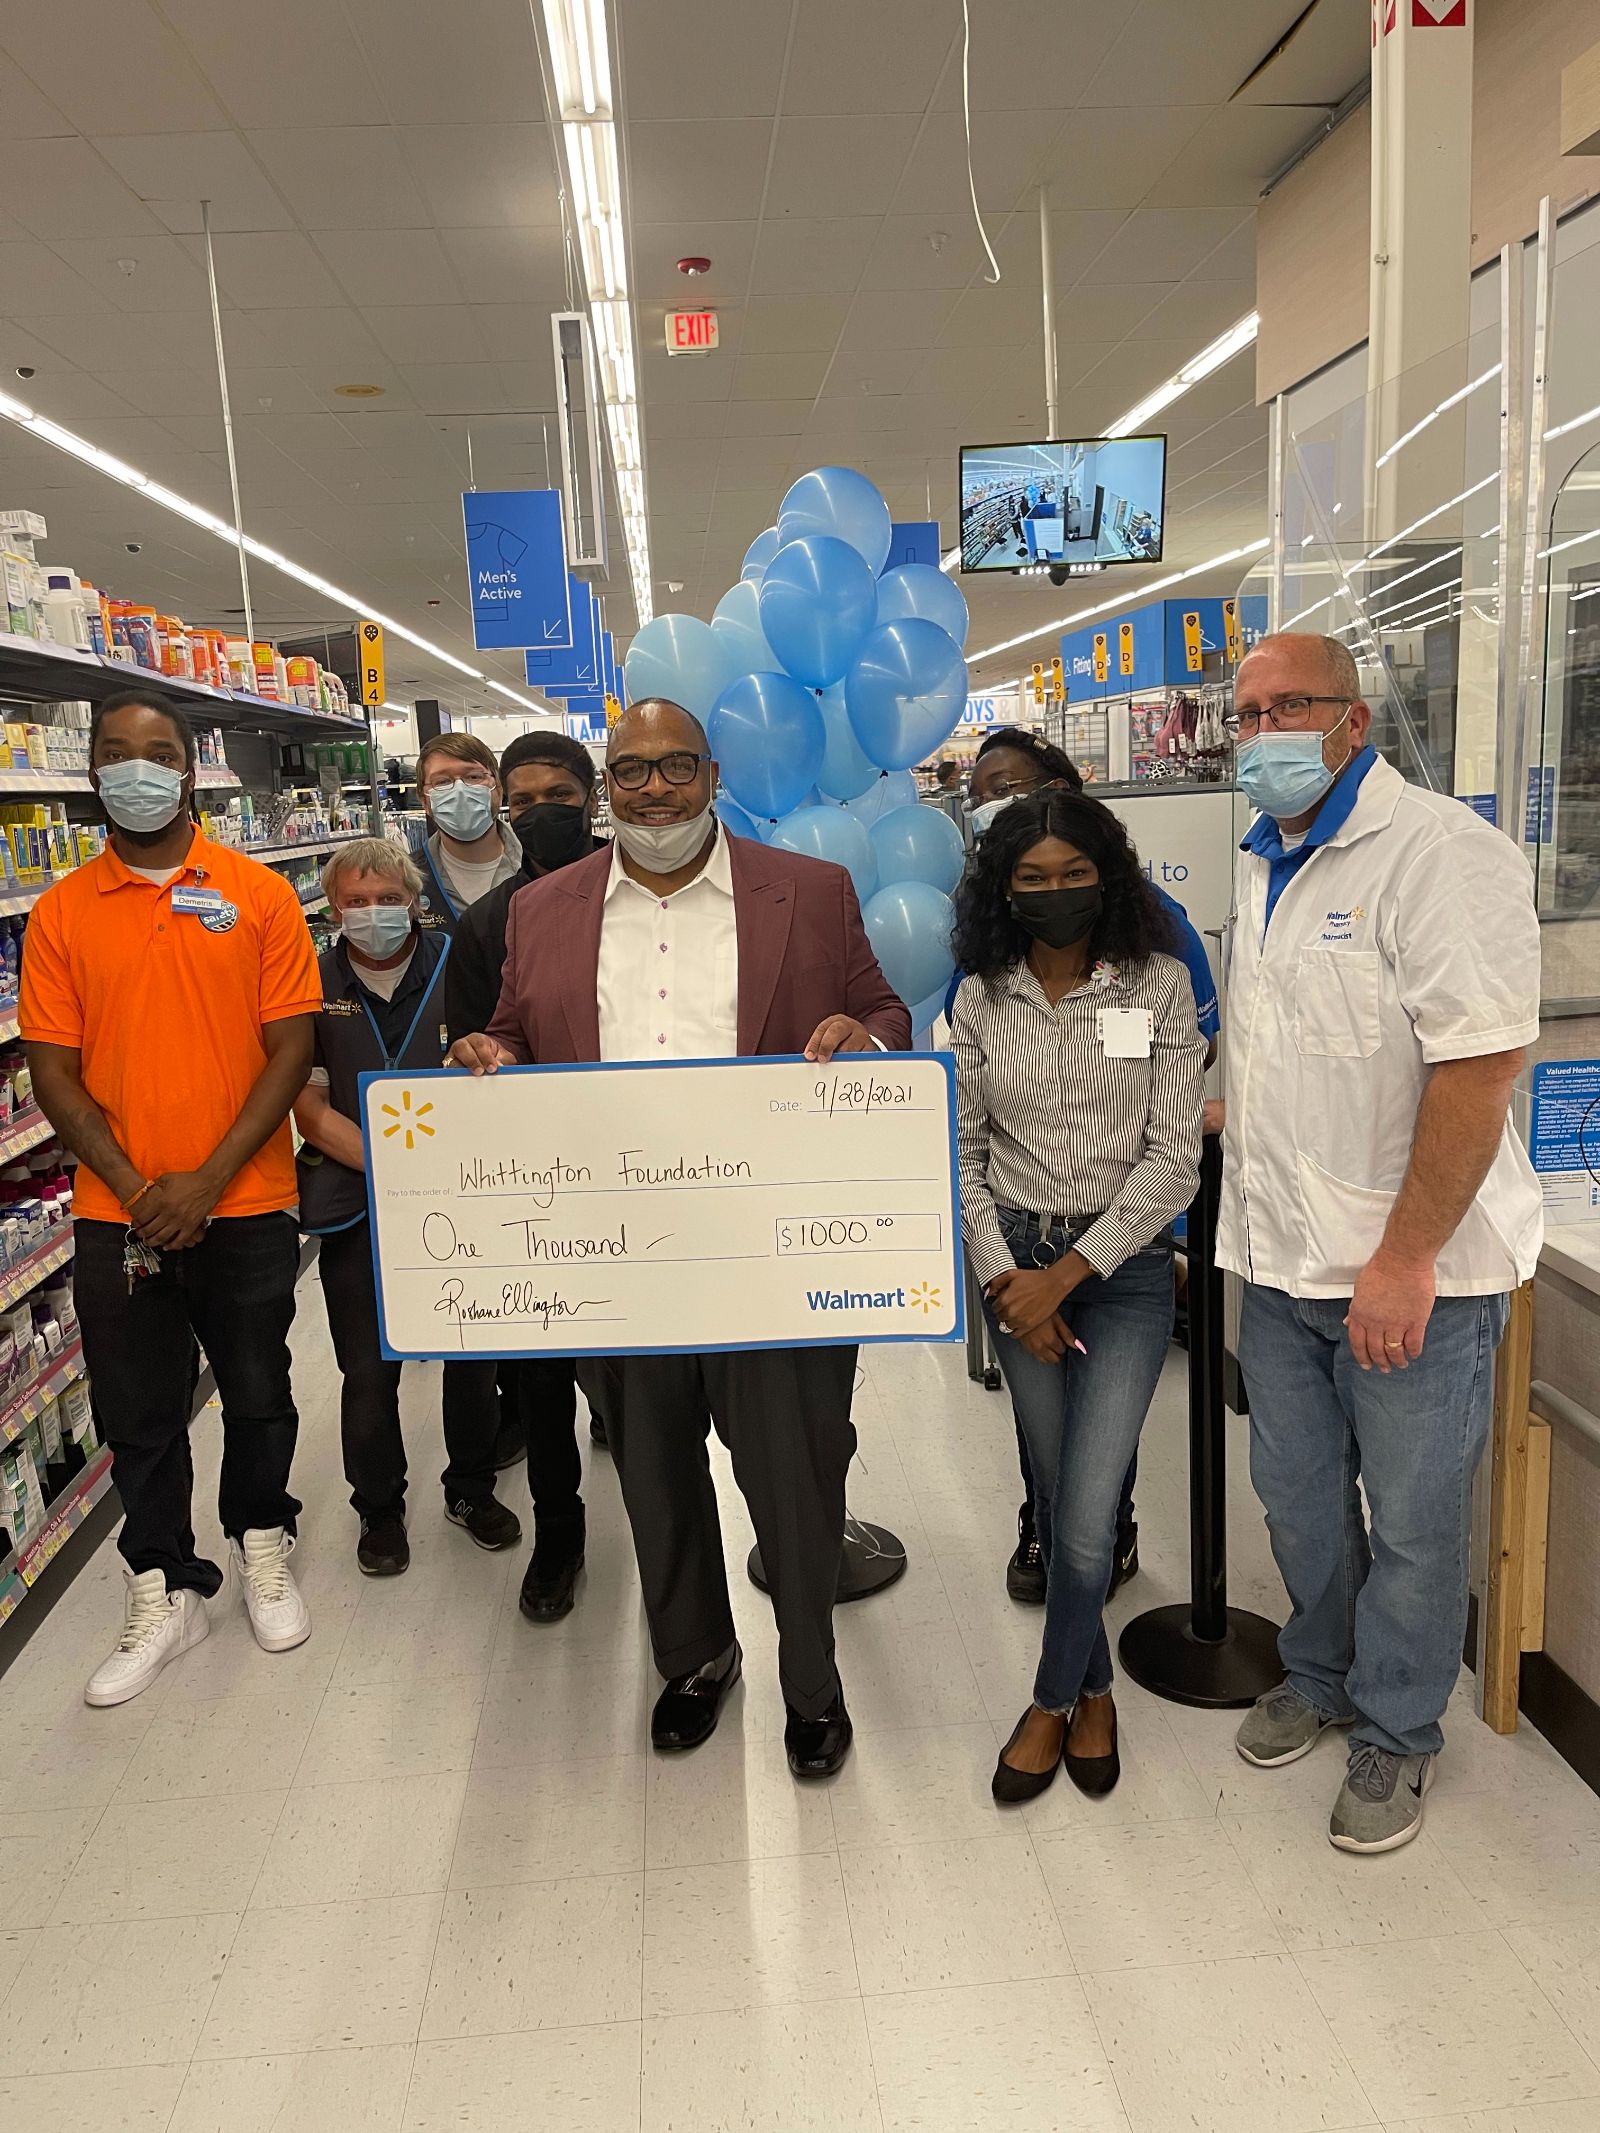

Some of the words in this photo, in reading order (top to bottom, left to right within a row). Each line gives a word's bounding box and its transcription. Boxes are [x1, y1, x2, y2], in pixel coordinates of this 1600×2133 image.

[674, 313, 712, 346] EXIT
[478, 570, 517, 584] Men's
[479, 586, 522, 600] Active
[1188, 645, 1198, 656] D
[1122, 652, 1130, 662] D
[1073, 655, 1091, 677] Fitting
[1096, 661, 1104, 670] D
[1124, 664, 1130, 673] 3
[1191, 659, 1199, 669] 2
[367, 668, 378, 683] B
[1097, 672, 1104, 680] 4
[1035, 686, 1042, 694] D
[1054, 681, 1061, 690] D
[368, 688, 379, 702] 4
[1036, 694, 1042, 703] 6
[1055, 690, 1062, 699] 5
[963, 699, 994, 723] OYS
[1161, 861, 1189, 882] to
[178, 897, 213, 908] Demetris
[322, 1001, 351, 1012] Walmart
[1546, 1067, 1571, 1075] Valued
[814, 1075, 912, 1118] 9/28/2021
[769, 1100, 803, 1113] Date:
[460, 1157, 591, 1209] Whittington
[618, 1150, 751, 1186] Foundation
[387, 1189, 399, 1198] Pay
[401, 1189, 408, 1197] to
[410, 1188, 421, 1197] the
[423, 1187, 441, 1196] order
[423, 1212, 483, 1261] One
[501, 1219, 628, 1260] Thousand
[806, 1287, 906, 1311] Walmart
